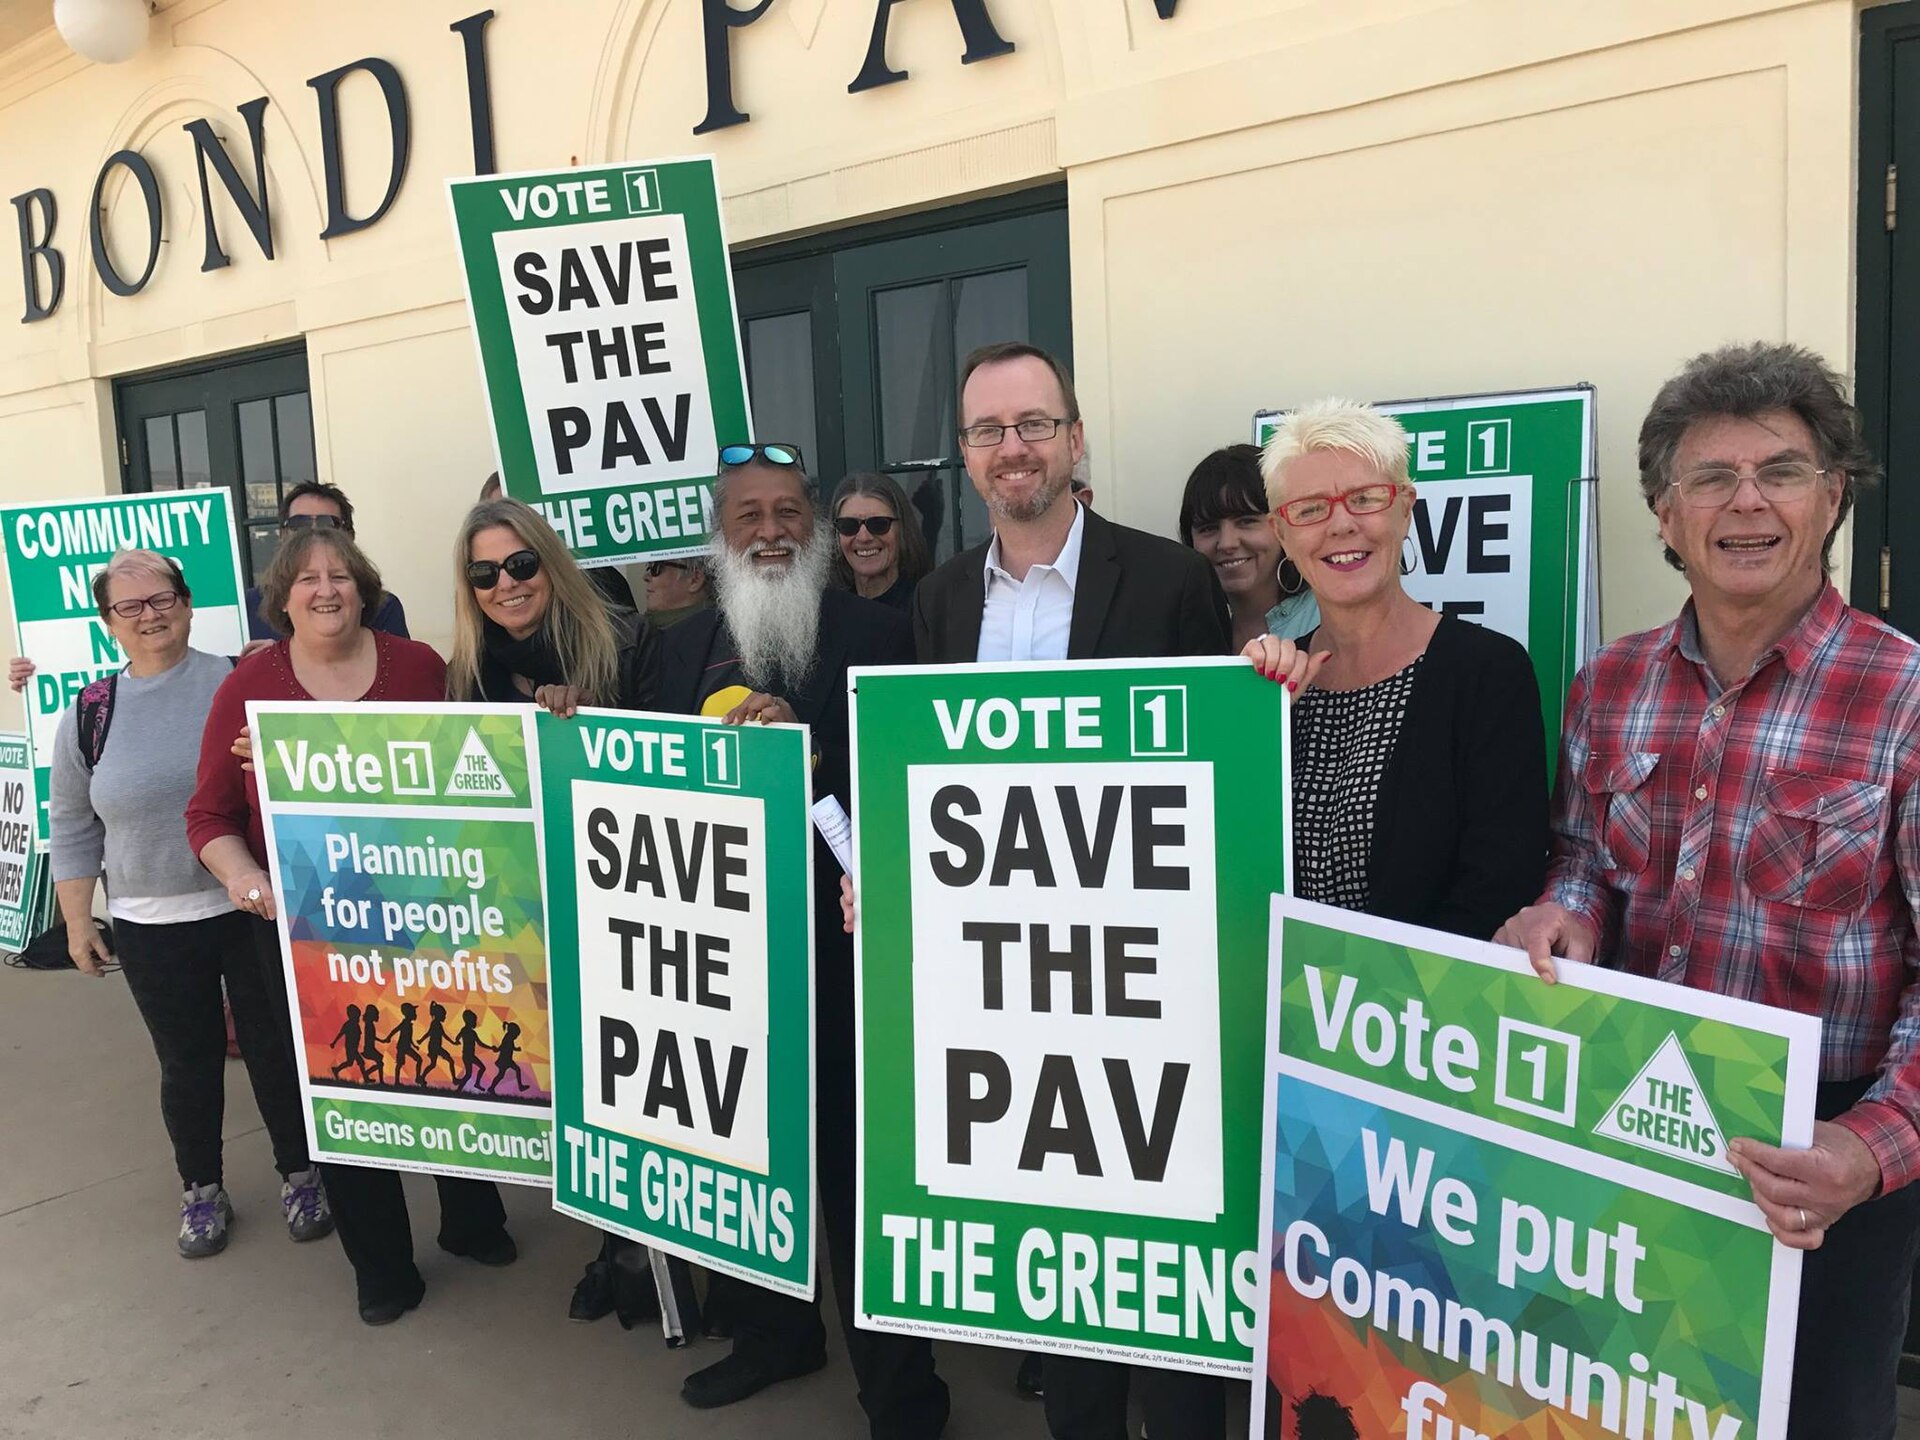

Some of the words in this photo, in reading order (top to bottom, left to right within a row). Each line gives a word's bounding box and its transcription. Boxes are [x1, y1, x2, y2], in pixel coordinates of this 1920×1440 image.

[11, 9, 496, 324] BONDI
[499, 179, 612, 221] VOTE
[632, 175, 650, 209] 1
[513, 238, 678, 315] SAVE
[545, 322, 672, 384] THE
[547, 393, 691, 475] PAV
[1478, 427, 1496, 468] 1
[16, 499, 212, 559] COMMUNITY
[932, 696, 1102, 750] VOTE
[1144, 694, 1167, 748] 1
[273, 740, 384, 794] Vote
[402, 752, 419, 785] 1
[454, 773, 502, 791] GREENS
[464, 754, 488, 772] THE
[579, 726, 687, 777] VOTE
[711, 737, 727, 781] 1
[3, 781, 24, 815] NO
[0, 820, 29, 855] ORE
[325, 832, 487, 890] Planning
[587, 807, 750, 913] SAVE
[929, 784, 1190, 891] SAVE
[321, 887, 372, 929] for
[381, 894, 505, 945] people
[327, 949, 386, 986] not
[393, 949, 513, 997] profits
[608, 917, 731, 1011] THE
[962, 920, 1162, 1019] THE
[1303, 964, 1480, 1093] Vote
[1520, 1044, 1548, 1101] 1
[600, 1015, 749, 1139] PAV
[1645, 1076, 1693, 1118] THE
[324, 1110, 416, 1147] Greens
[420, 1126, 454, 1151] on
[945, 1047, 1191, 1183] PAV
[1616, 1103, 1716, 1157] GREENS
[564, 1125, 628, 1211] THE
[640, 1150, 795, 1263] GREENS
[1360, 1127, 1478, 1246] We
[1497, 1197, 1647, 1315] put
[882, 1214, 996, 1314] THE
[1016, 1226, 1258, 1349] GREENS
[876, 1319, 905, 1329] Authorised
[906, 1322, 913, 1331] by
[914, 1323, 928, 1332] Chris
[948, 1327, 962, 1336] Suite
[1026, 1337, 1042, 1346] Glebe
[1043, 1340, 1057, 1348] NSW
[1074, 1344, 1095, 1352] Printed
[1106, 1348, 1132, 1358] Wombat
[1207, 1361, 1242, 1373] Moorebank
